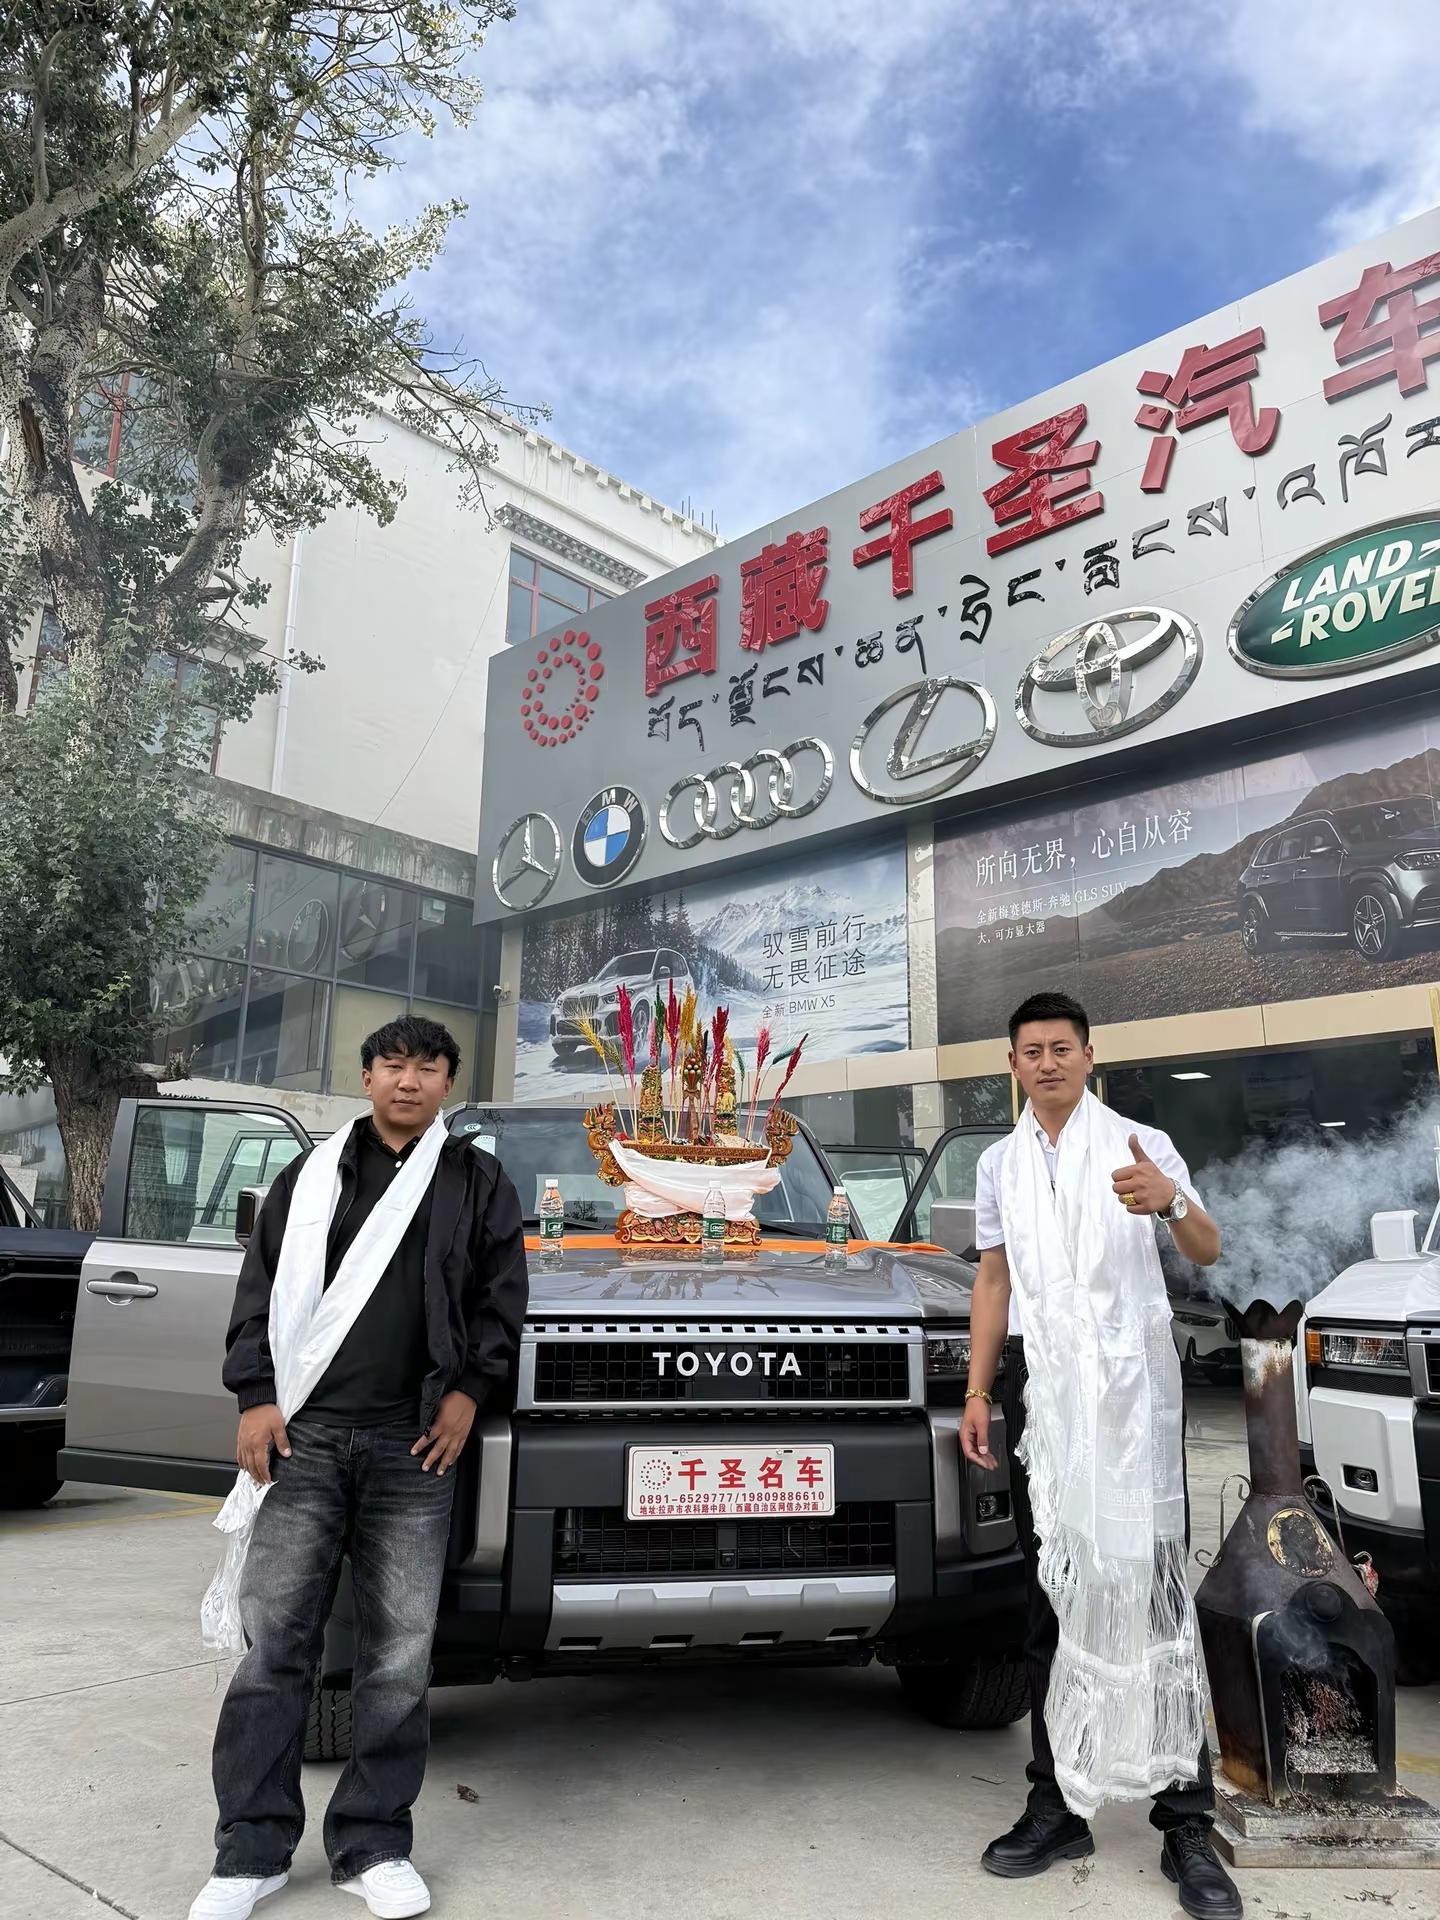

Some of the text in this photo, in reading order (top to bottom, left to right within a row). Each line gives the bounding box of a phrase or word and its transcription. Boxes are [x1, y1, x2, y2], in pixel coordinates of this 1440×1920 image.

[1281, 539, 1413, 614] LAND
[581, 788, 639, 825] BMW
[1075, 887, 1098, 903] GLS
[1101, 880, 1127, 898] SUV
[762, 914, 866, 959] 驭雪前行
[762, 948, 866, 992] 无畏征途
[762, 995, 836, 1019] 全新 BMW X5
[652, 1351, 802, 1376] TOYOTA
[678, 1456, 824, 1490] 千圣名车
[639, 1491, 825, 1504] 0891-6529777/19809886610
